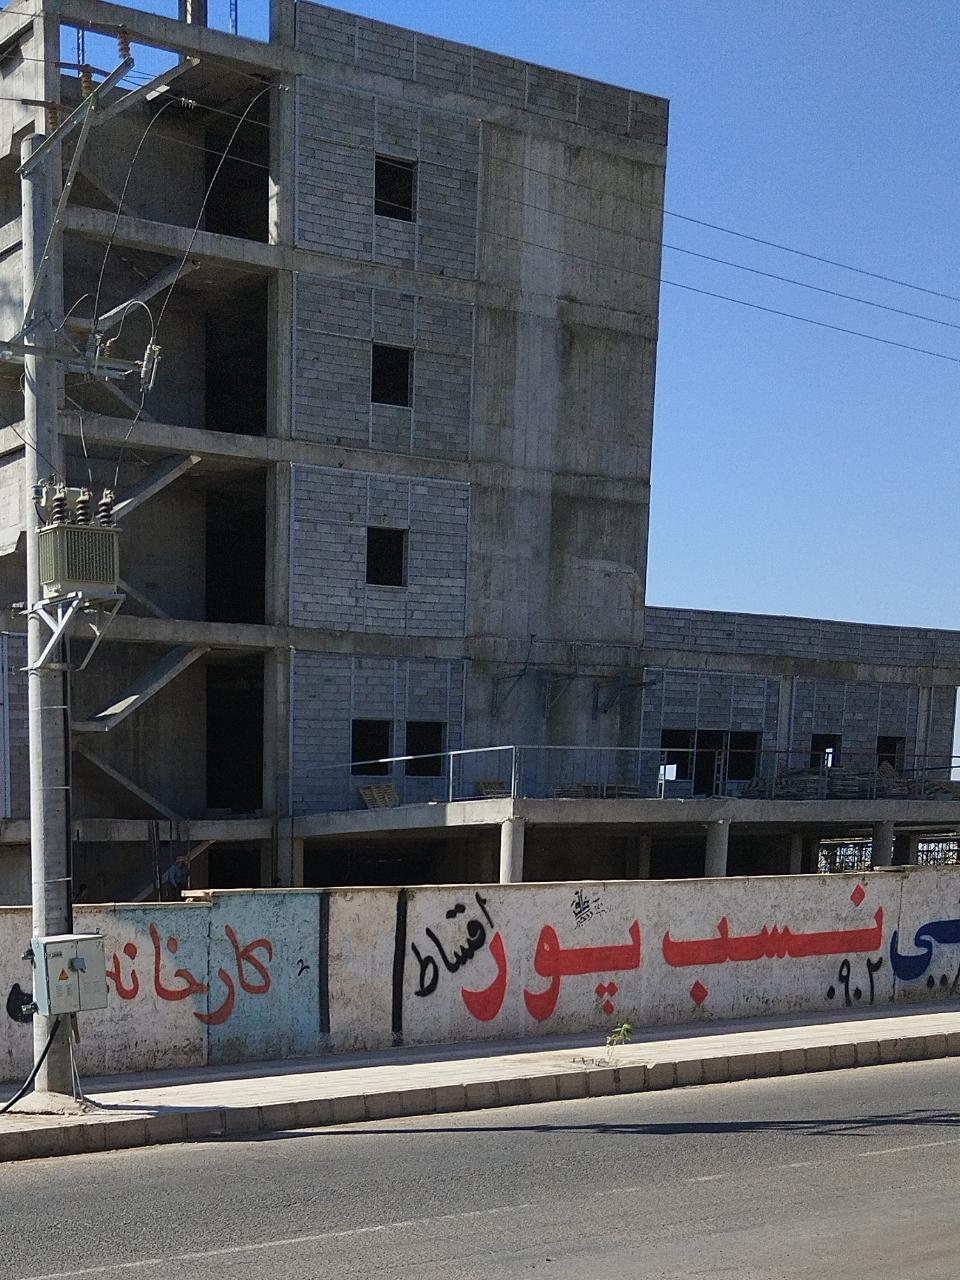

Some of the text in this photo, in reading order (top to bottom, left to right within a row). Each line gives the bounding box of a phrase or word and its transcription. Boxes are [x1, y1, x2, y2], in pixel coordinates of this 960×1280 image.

[106, 923, 274, 1025] کارخان
[411, 891, 494, 997] اقساط
[461, 919, 641, 1021] پور
[663, 883, 884, 1007] نسب
